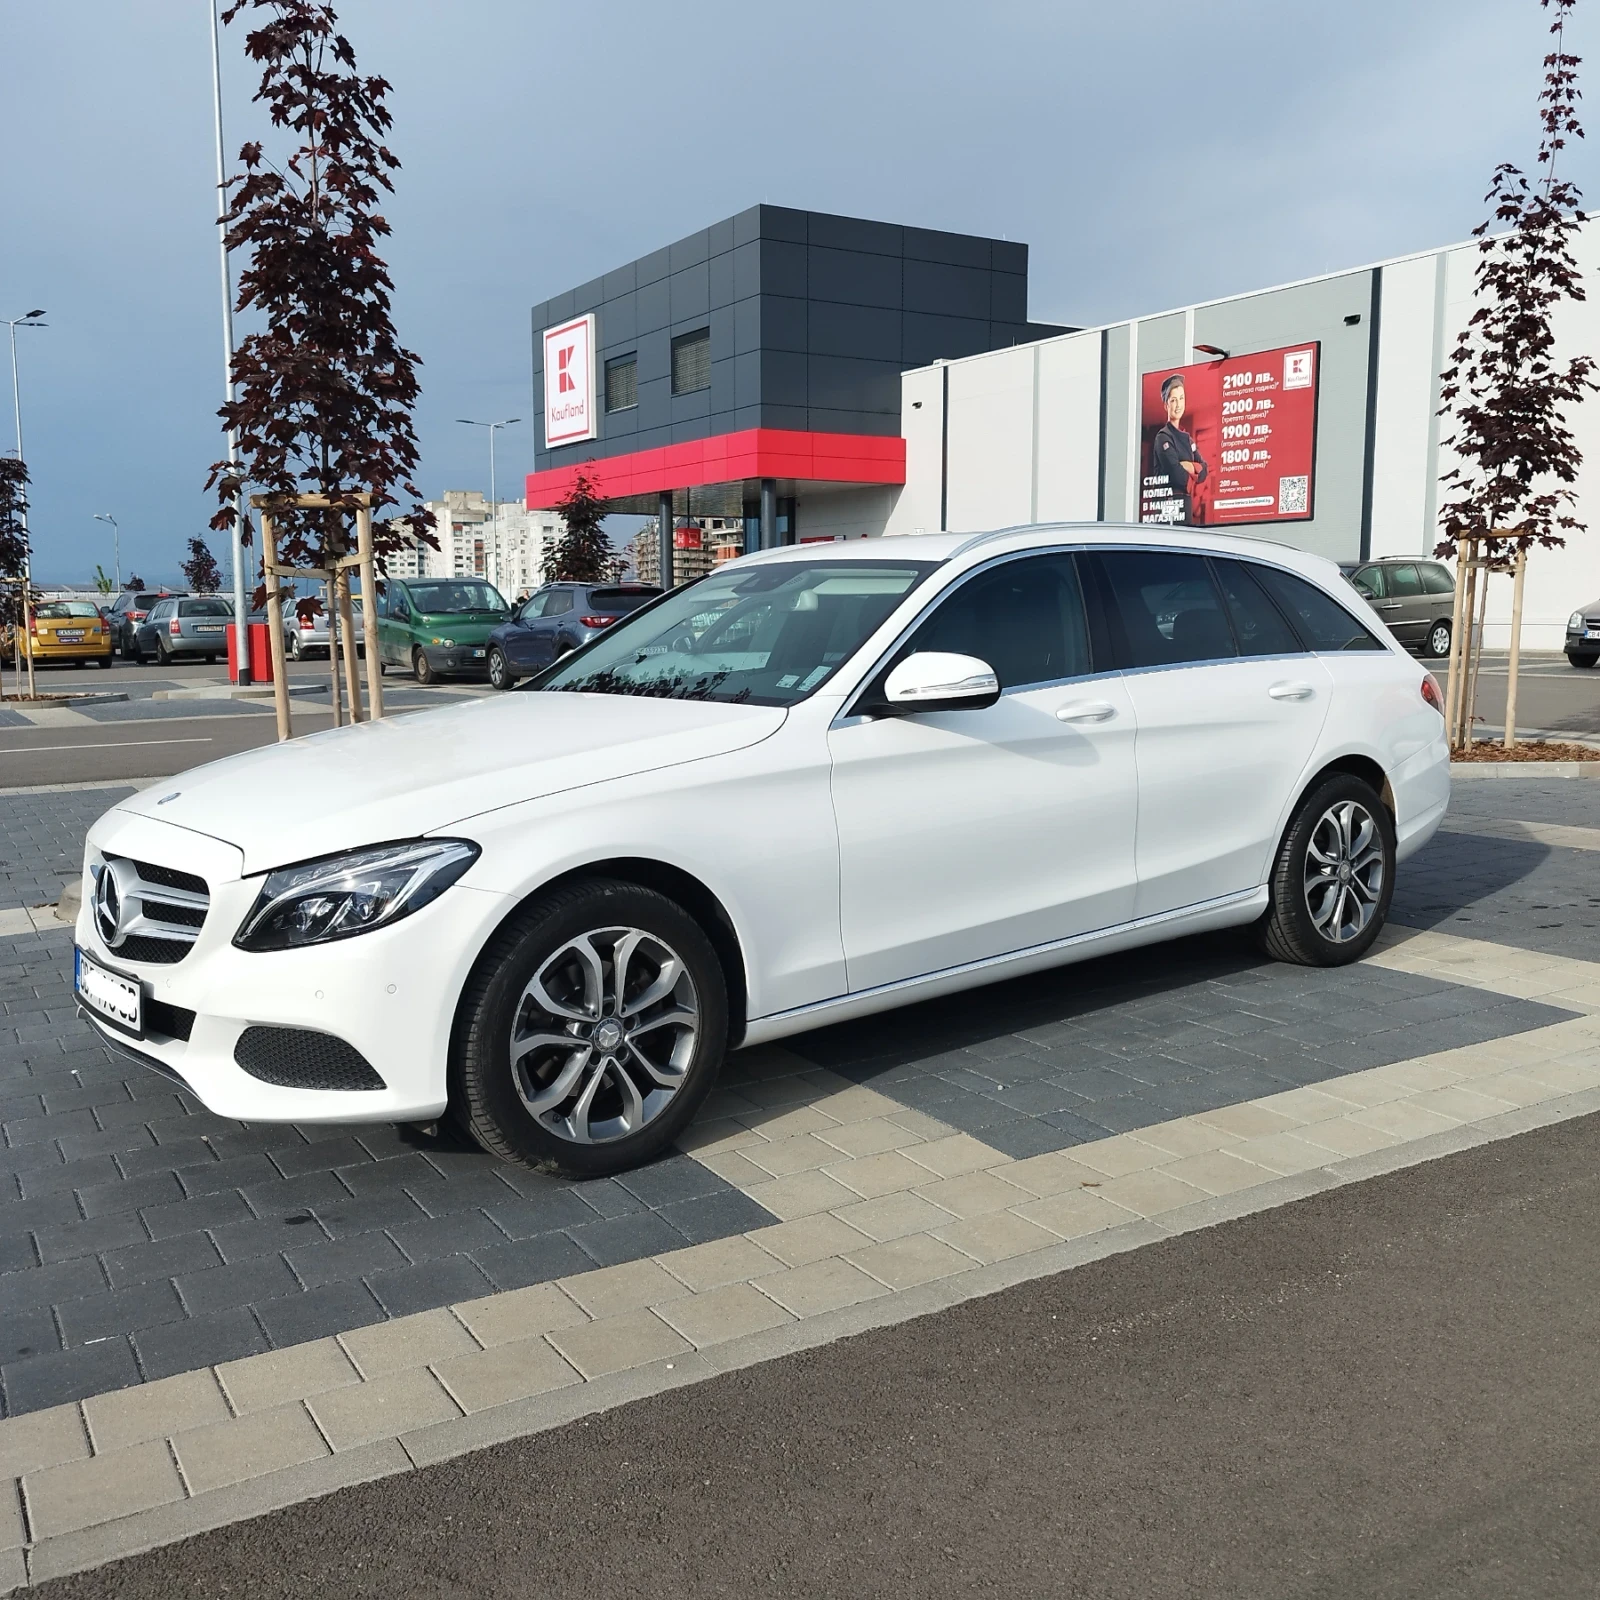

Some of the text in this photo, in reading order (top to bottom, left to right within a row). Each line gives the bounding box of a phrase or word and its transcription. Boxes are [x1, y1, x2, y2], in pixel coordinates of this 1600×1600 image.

[1223, 371, 1274, 389] 2100 лв.
[551, 400, 584, 423] Kaufland
[1222, 398, 1275, 415] 2000 лв.
[1221, 423, 1272, 439] 1900 лв.
[1220, 448, 1271, 464] 1800 лв.
[1143, 475, 1169, 486] СТАНИ
[1143, 487, 1173, 499] КОЛЕГА
[1142, 502, 1148, 511] В
